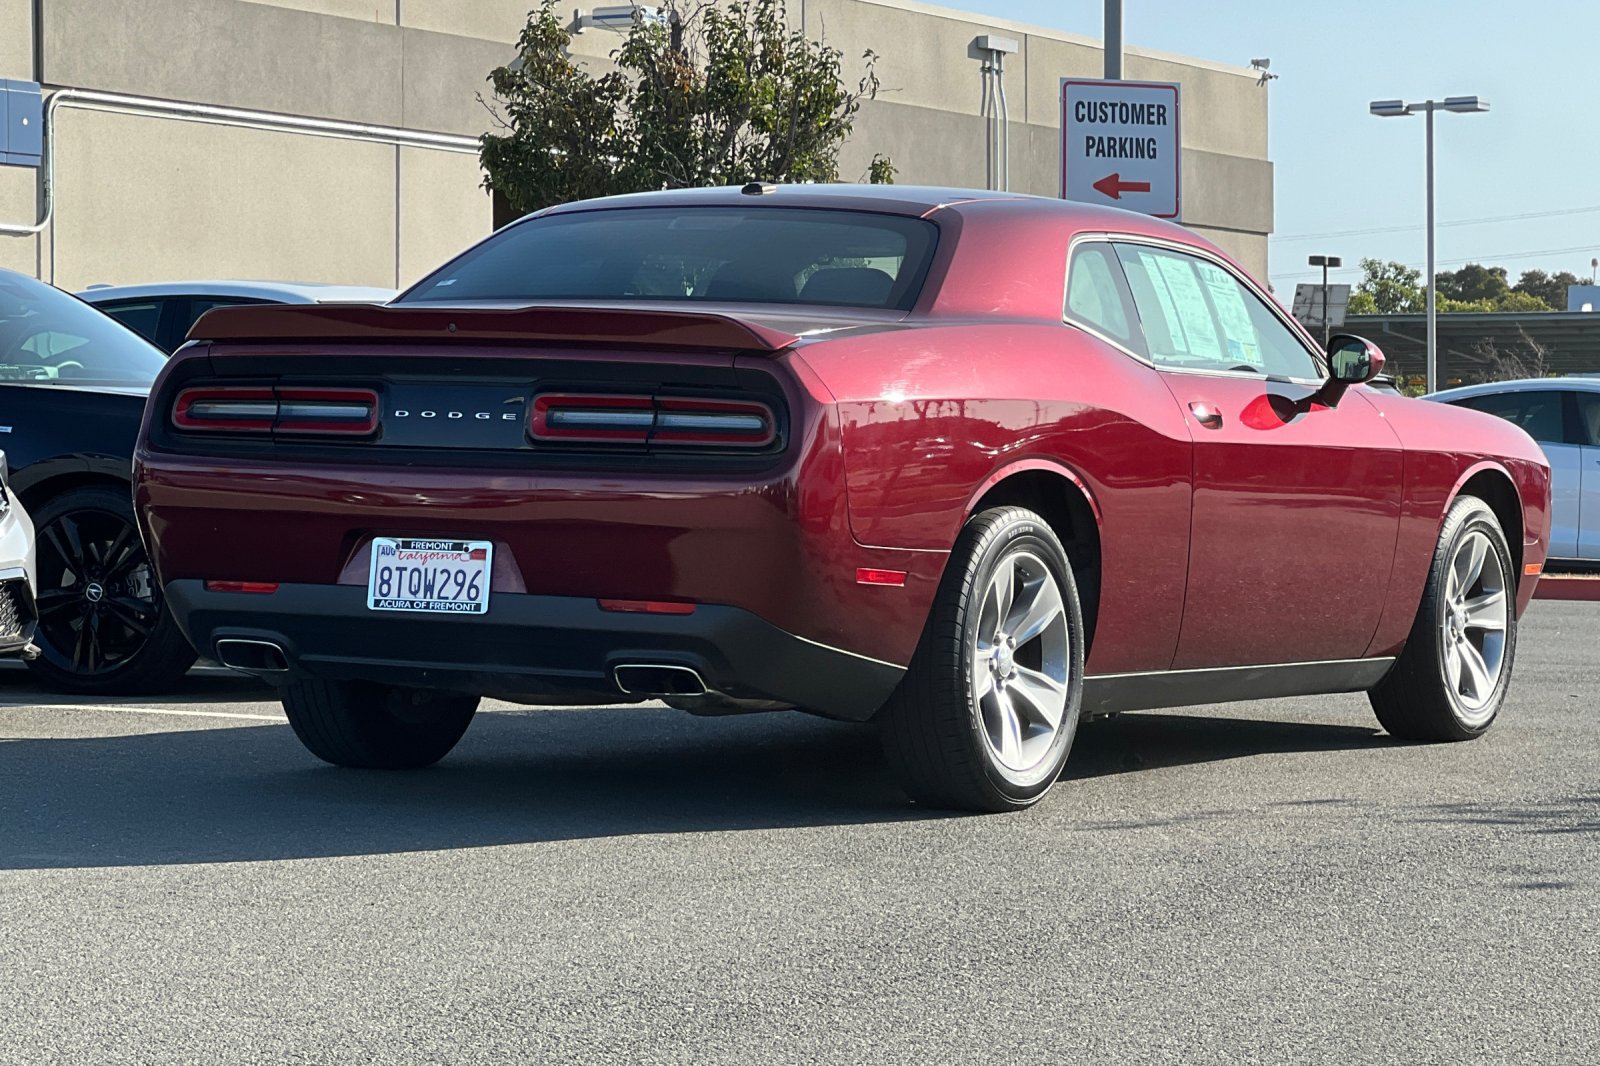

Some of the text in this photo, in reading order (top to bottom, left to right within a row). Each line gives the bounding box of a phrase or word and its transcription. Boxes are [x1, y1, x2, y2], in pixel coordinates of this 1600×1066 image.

[1074, 100, 1167, 126] CUSTOMER
[1085, 135, 1157, 160] PARKING
[394, 410, 517, 420] DODGE
[380, 546, 396, 556] AUG
[410, 541, 454, 551] FREMONT
[398, 551, 468, 565] California
[378, 566, 482, 602] 8TQW296
[379, 600, 476, 611] ACURA OF FREMONT
